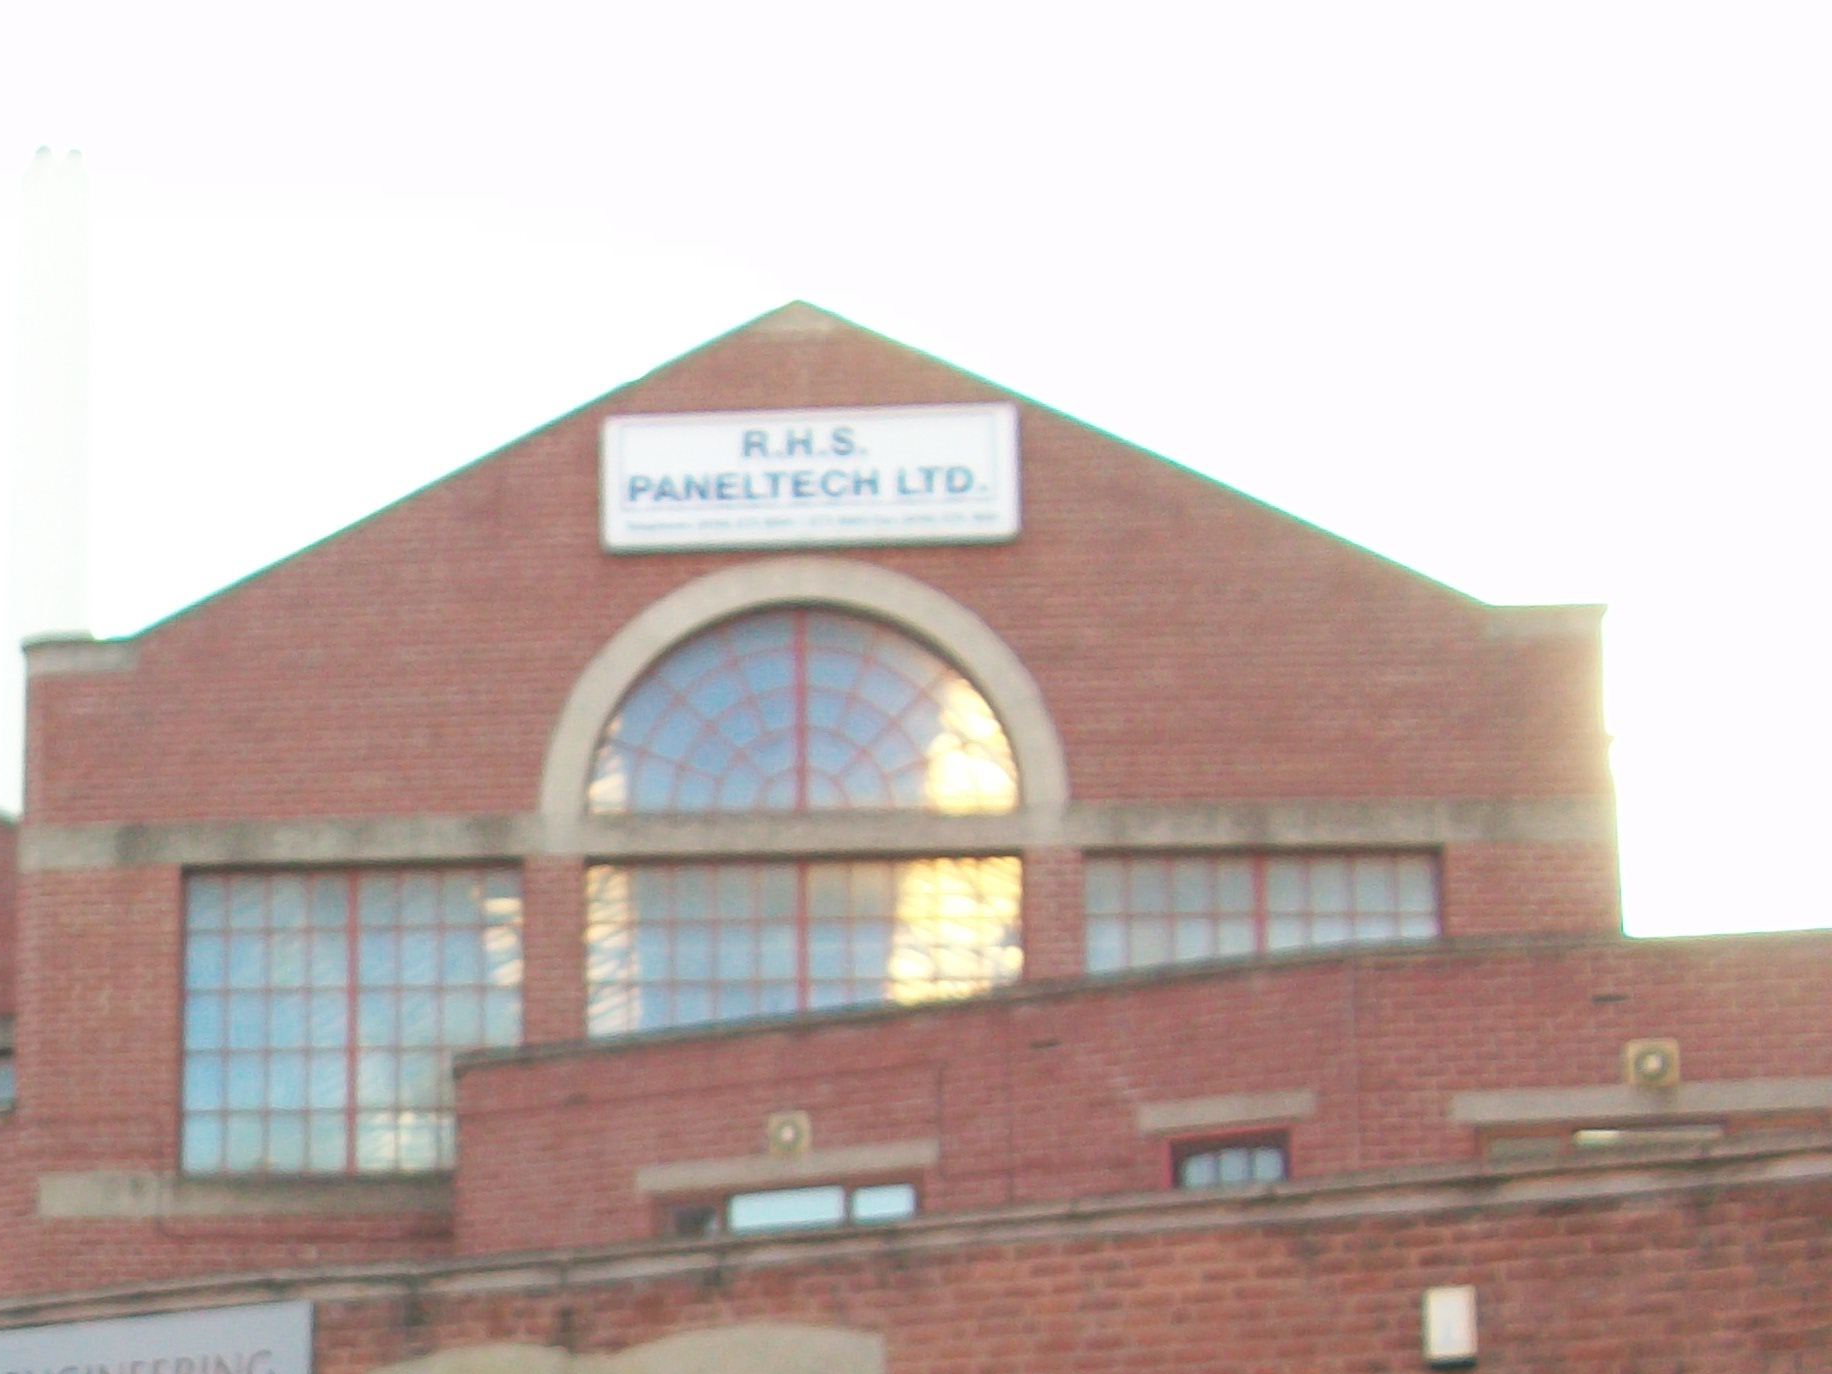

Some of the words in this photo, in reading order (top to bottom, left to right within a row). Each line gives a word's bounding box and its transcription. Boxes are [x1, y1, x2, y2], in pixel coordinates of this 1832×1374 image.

[741, 426, 870, 458] R.H.S.
[627, 468, 880, 503] PANELTECH
[896, 464, 989, 495] LTD.
